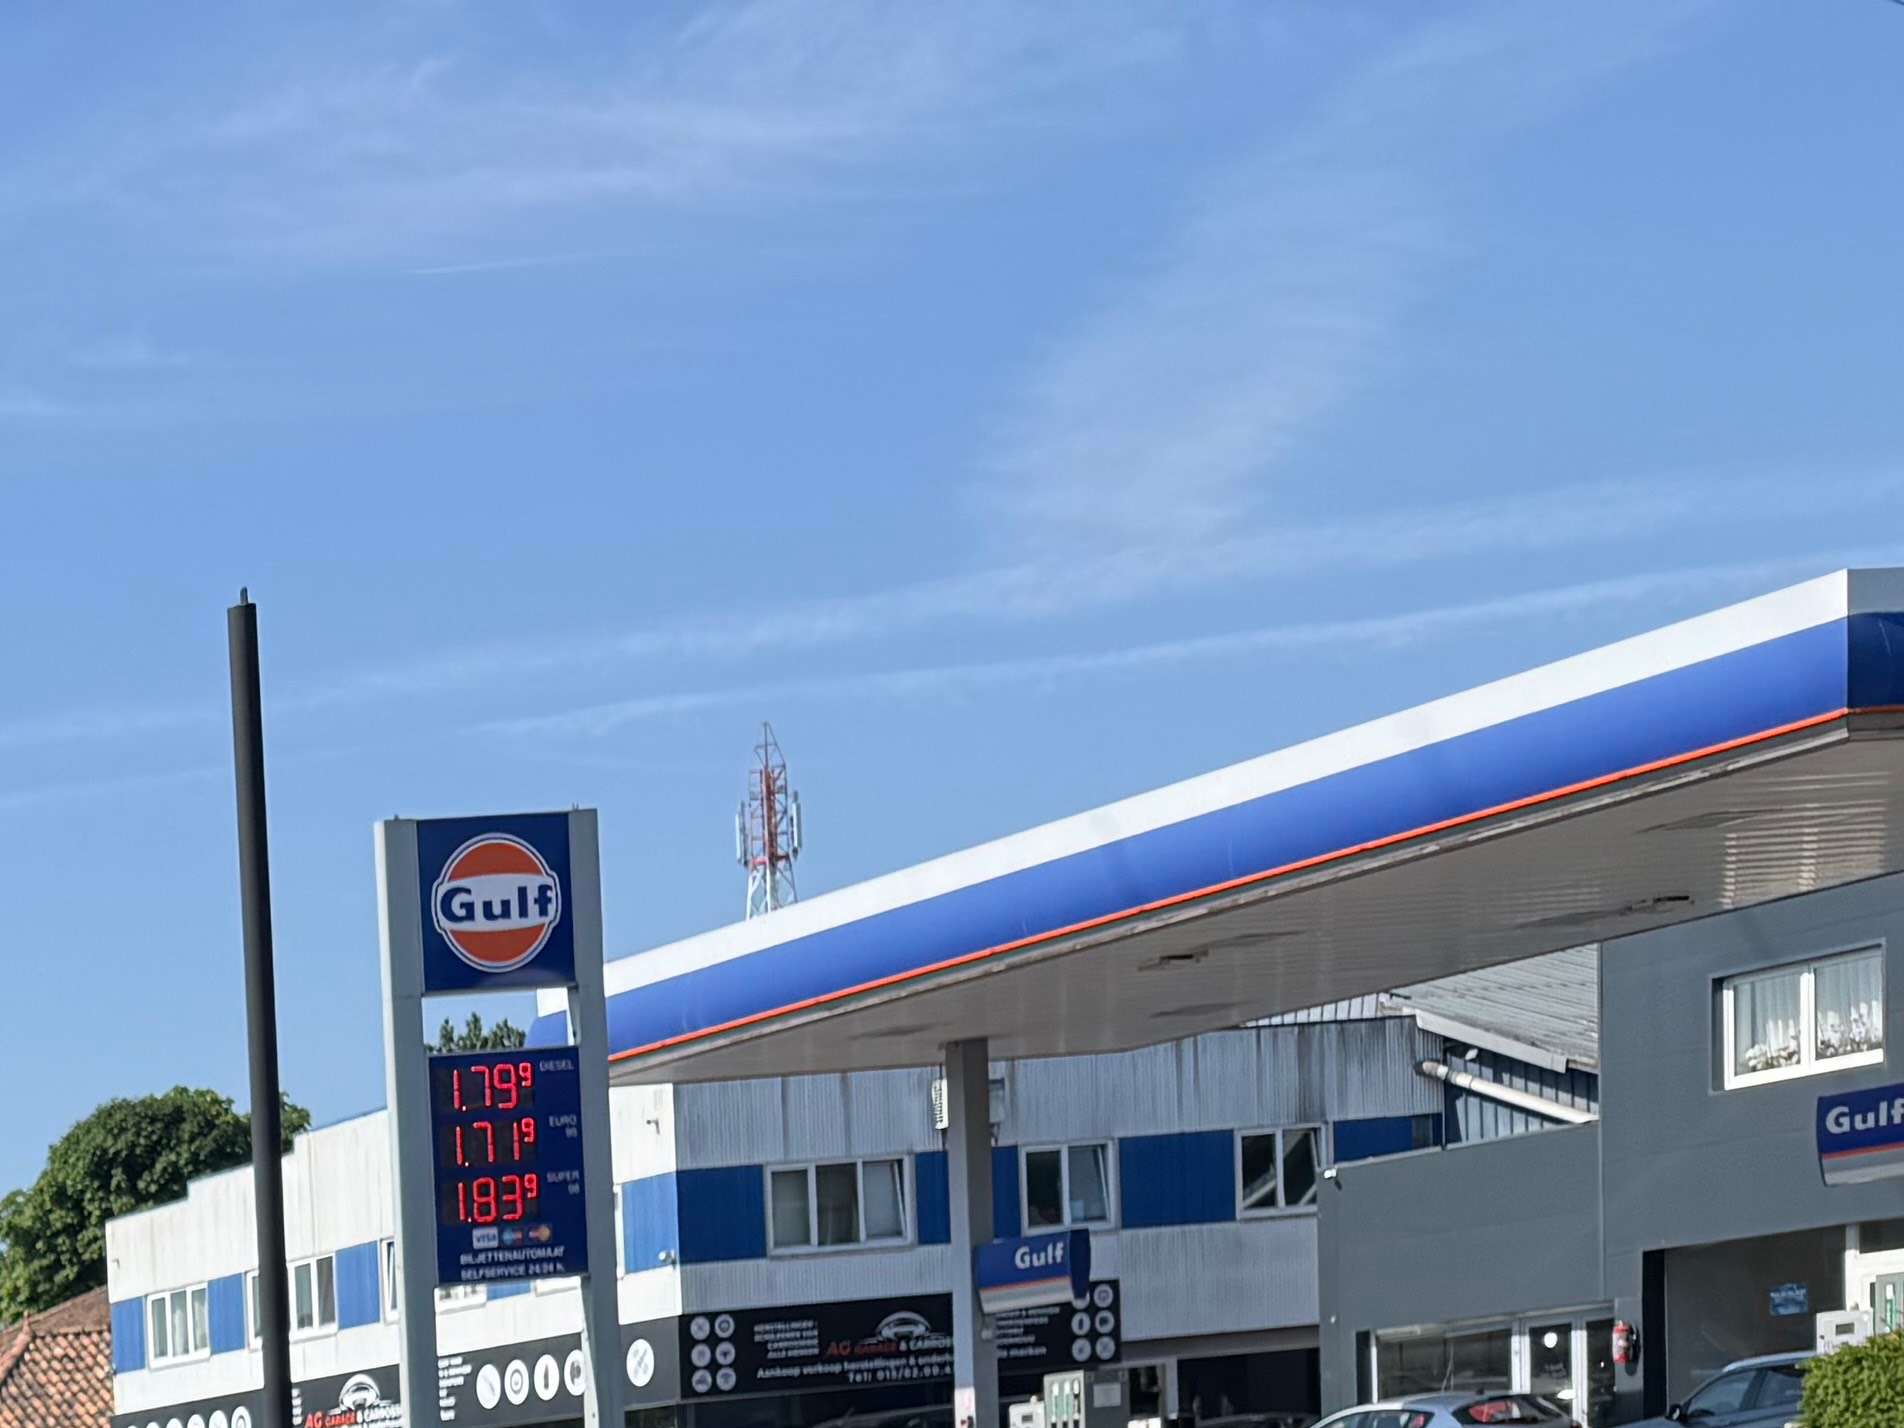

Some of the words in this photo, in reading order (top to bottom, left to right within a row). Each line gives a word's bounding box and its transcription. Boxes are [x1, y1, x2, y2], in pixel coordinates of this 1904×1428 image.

[441, 885, 553, 923] Gulf
[540, 1058, 574, 1072] DIESEL
[548, 1114, 577, 1128] EURO
[1825, 1097, 1904, 1135] Gulf
[547, 1170, 580, 1184] SUPER
[1014, 1241, 1065, 1270] Gulf
